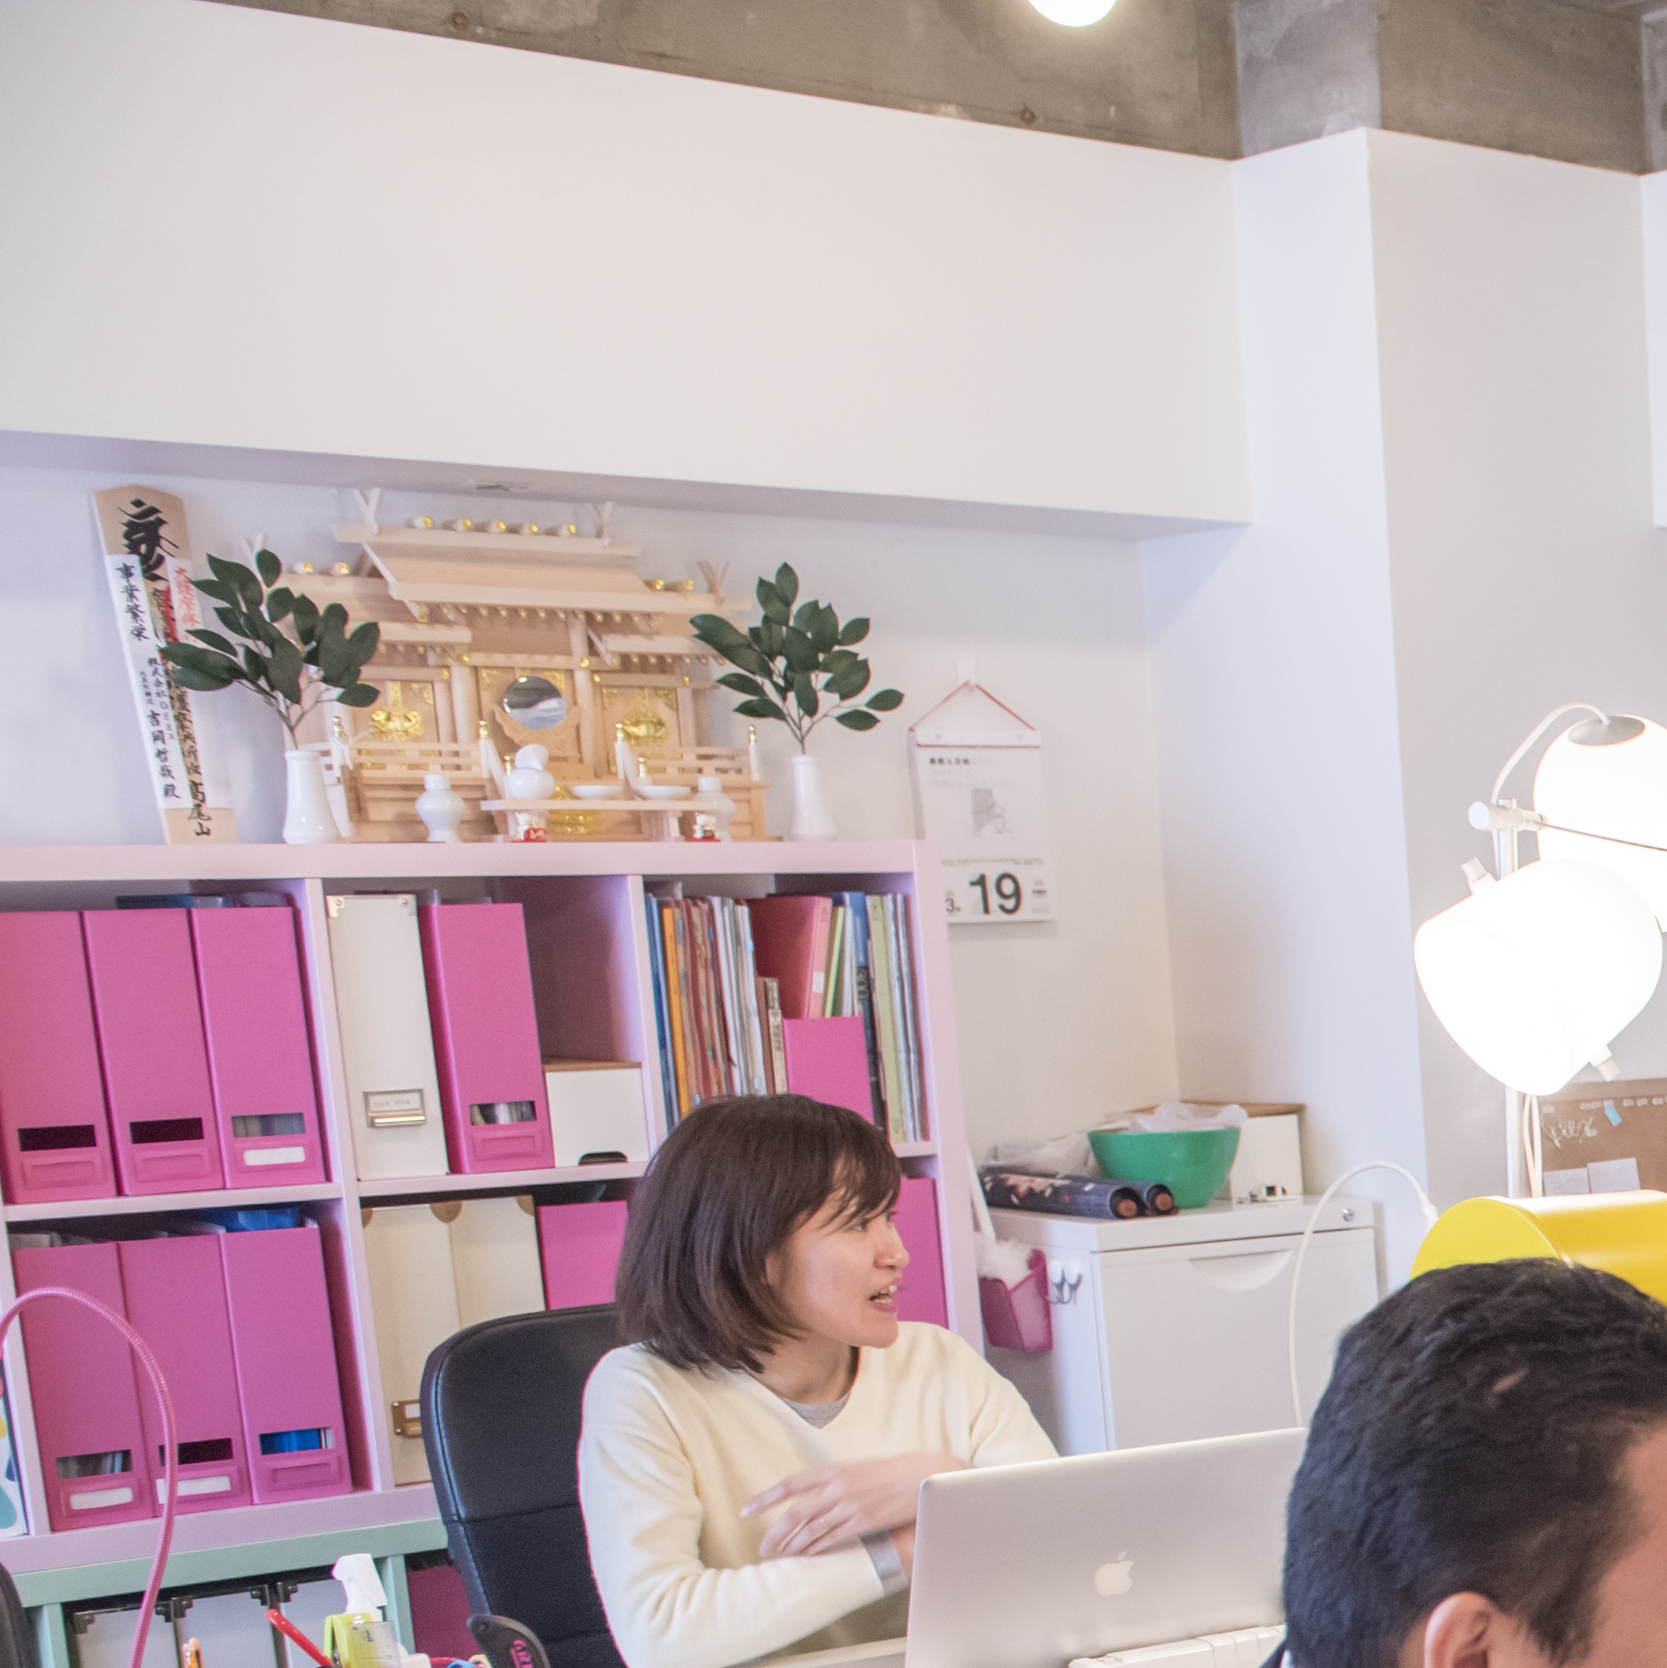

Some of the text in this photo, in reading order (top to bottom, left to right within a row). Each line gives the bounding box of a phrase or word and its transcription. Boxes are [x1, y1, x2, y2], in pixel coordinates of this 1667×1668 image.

[115, 562, 150, 642] 事業繁栄
[968, 872, 1023, 915] 19
